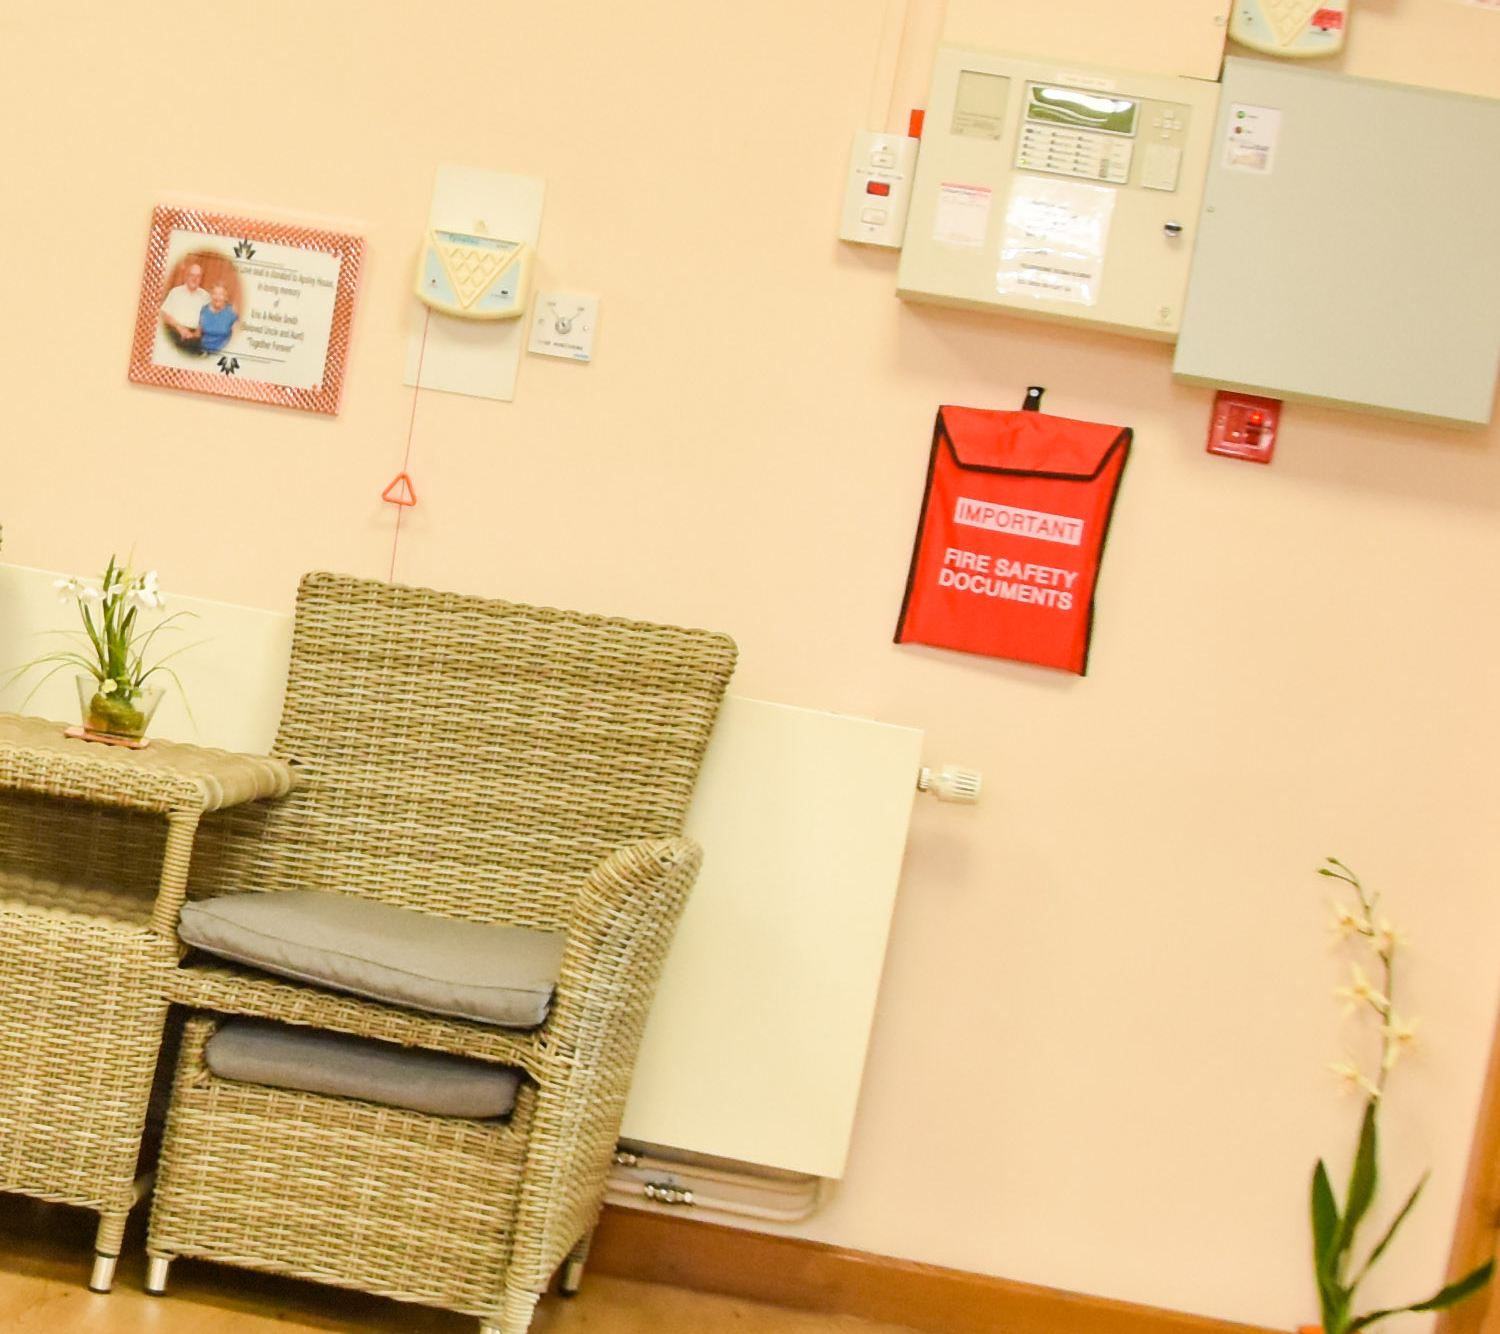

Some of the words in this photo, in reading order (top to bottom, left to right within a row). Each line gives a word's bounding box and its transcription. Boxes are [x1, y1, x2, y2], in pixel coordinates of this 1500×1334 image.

[959, 502, 1080, 541] IMPORTANT
[938, 567, 1073, 611] DOCUMENTS
[944, 547, 992, 574] FIRE
[995, 558, 1078, 589] SAFETY
